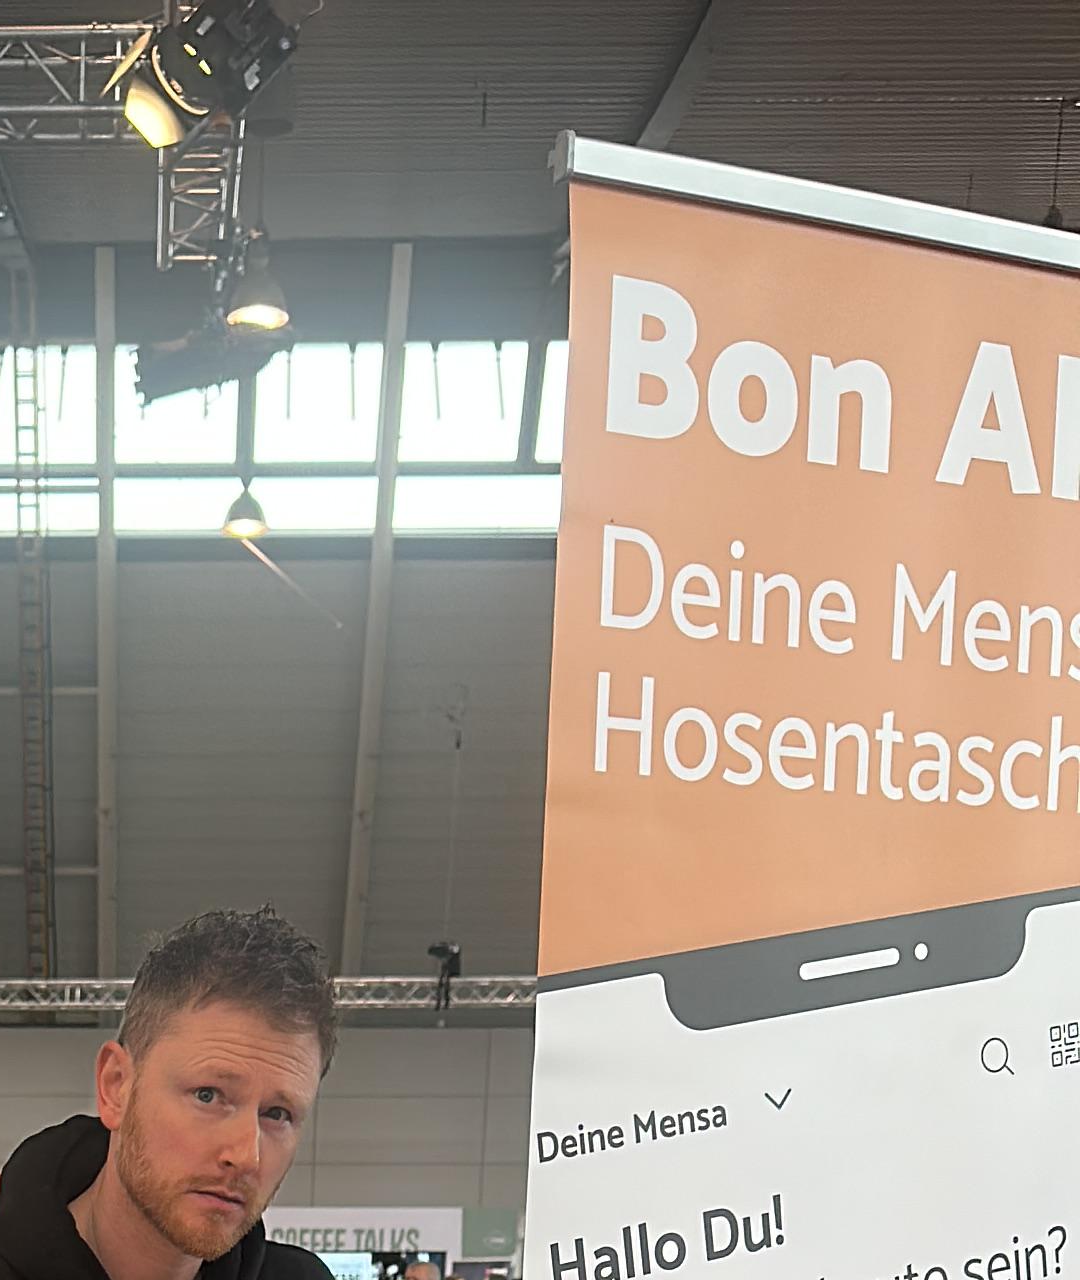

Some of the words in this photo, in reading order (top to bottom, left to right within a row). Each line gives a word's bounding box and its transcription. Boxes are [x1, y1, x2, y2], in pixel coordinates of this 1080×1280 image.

[607, 274, 891, 473] Bon
[600, 525, 858, 654] Deine
[594, 671, 1080, 814] Hosentasch
[536, 1122, 624, 1164] Deine
[633, 1103, 728, 1150] Mensa
[703, 1194, 787, 1260] Du!
